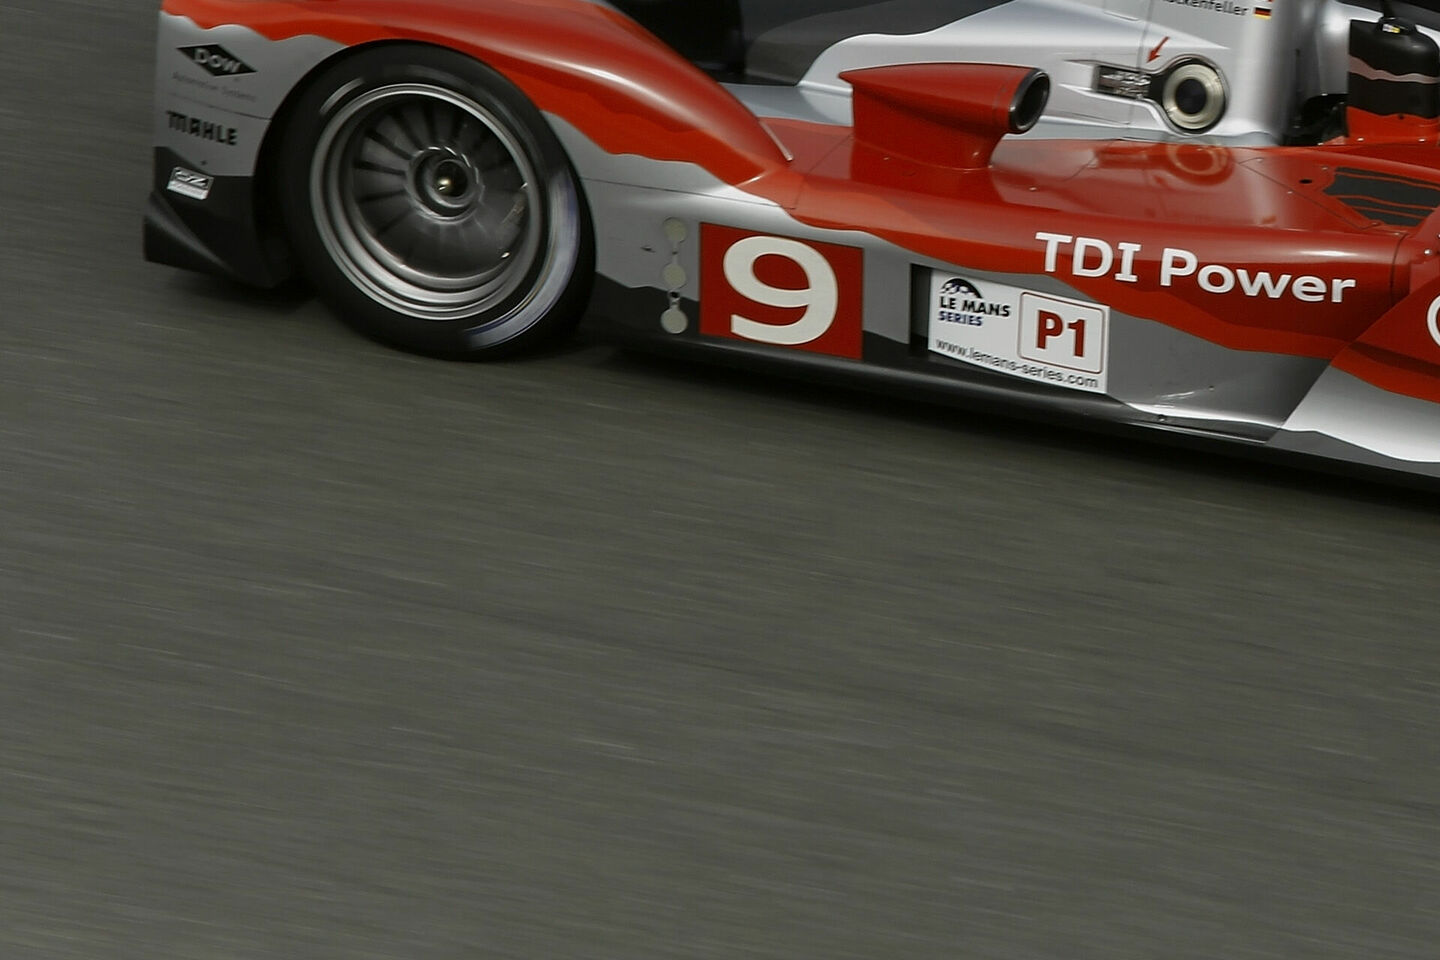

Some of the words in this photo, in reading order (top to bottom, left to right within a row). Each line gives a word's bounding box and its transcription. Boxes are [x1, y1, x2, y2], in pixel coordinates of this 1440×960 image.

[194, 48, 240, 73] DOW
[166, 110, 238, 146] MAHLE
[1035, 232, 1141, 283] TDI
[1160, 247, 1356, 303] Power
[723, 235, 839, 346] 9
[940, 296, 956, 310] LE
[962, 299, 1011, 318] MANS
[938, 311, 983, 327] SERIES
[1036, 309, 1087, 358] P1
[936, 339, 1099, 388] www.lemans-series.com
